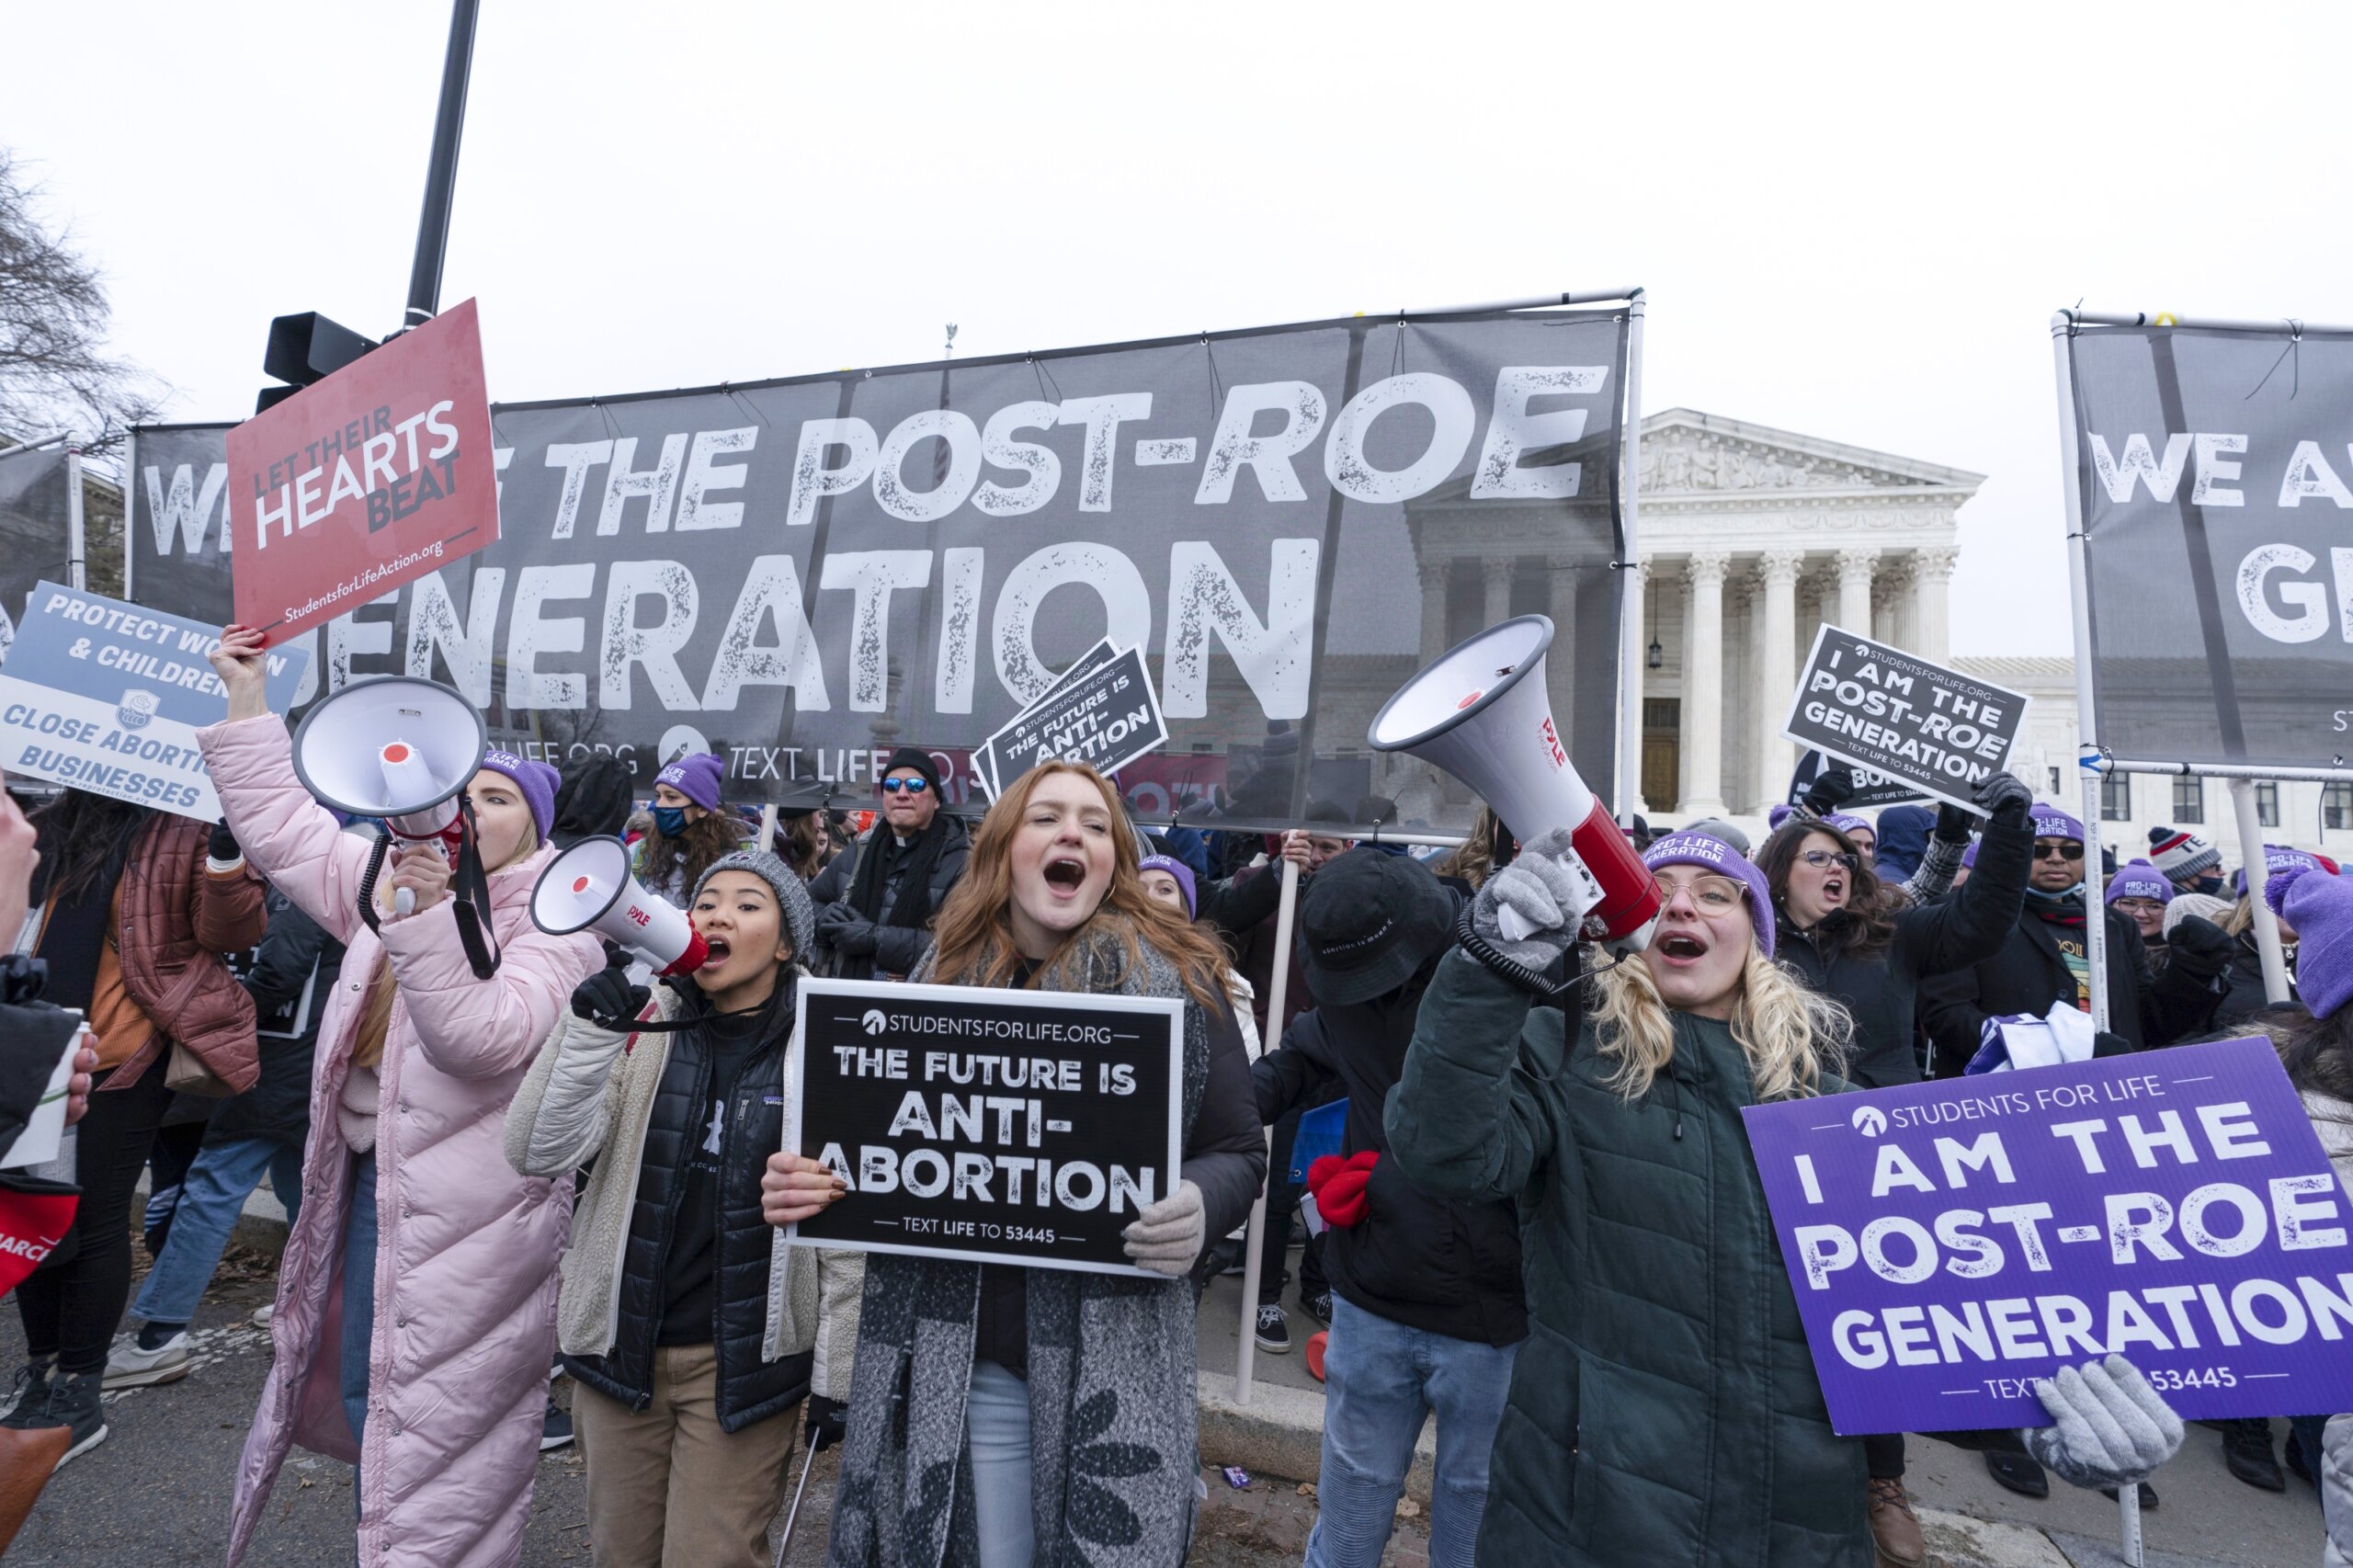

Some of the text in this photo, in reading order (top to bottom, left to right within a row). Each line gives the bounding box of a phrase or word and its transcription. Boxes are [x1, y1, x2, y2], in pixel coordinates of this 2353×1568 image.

[254, 404, 392, 499] LET THEIR
[256, 400, 459, 551] HEARTS
[545, 426, 758, 539] THE
[786, 366, 1608, 525] POST-ROE
[2088, 432, 2353, 508] WE A
[366, 449, 460, 534] BEAT
[285, 540, 444, 623] StudentsforLifeAction.org
[44, 594, 176, 644] PROTECT
[177, 630, 288, 677] WON
[69, 637, 230, 699] & CHILDREN
[1829, 650, 2003, 729] I AM THE
[1870, 650, 1993, 701] STUDENTSFORLIFE.ORG
[3, 704, 100, 744] CLOSE
[1006, 675, 1131, 760] THE FUTURE IS
[1025, 668, 1116, 731] STUDENTSFORLIFE.ORG
[1810, 669, 2008, 761] POST-ROE
[729, 747, 802, 780] TEXT
[817, 748, 891, 783] LIFE
[1035, 710, 1109, 767] ANTI-
[1542, 716, 1566, 767] PYLE
[1804, 701, 1991, 784] GENERATION
[1847, 742, 1932, 779] TEXT LIFE TO 53445
[18, 745, 201, 808] BUSINESSES
[55, 777, 151, 805] www.reprotection.org
[2035, 817, 2068, 828] O-LIFE
[2035, 826, 2069, 836] ERATION
[626, 904, 652, 927] PYLE
[2125, 881, 2163, 892] PRO-LIFE
[889, 1015, 1111, 1044] STUDENTSFORLIFE.ORG
[834, 1045, 1137, 1096] THE FUTURE IS
[1892, 1074, 2165, 1129] STUDENTS FOR LIFE
[887, 1090, 1073, 1147] ANTI-
[816, 1142, 1155, 1214] ABORTION
[1793, 1101, 2272, 1204] I AM THE
[903, 1216, 1055, 1244] TEXT LIFE TO 53445
[1793, 1173, 2348, 1290] POST-ROE
[1832, 1272, 2353, 1369] GENERATION
[2149, 1366, 2238, 1392] 53445
